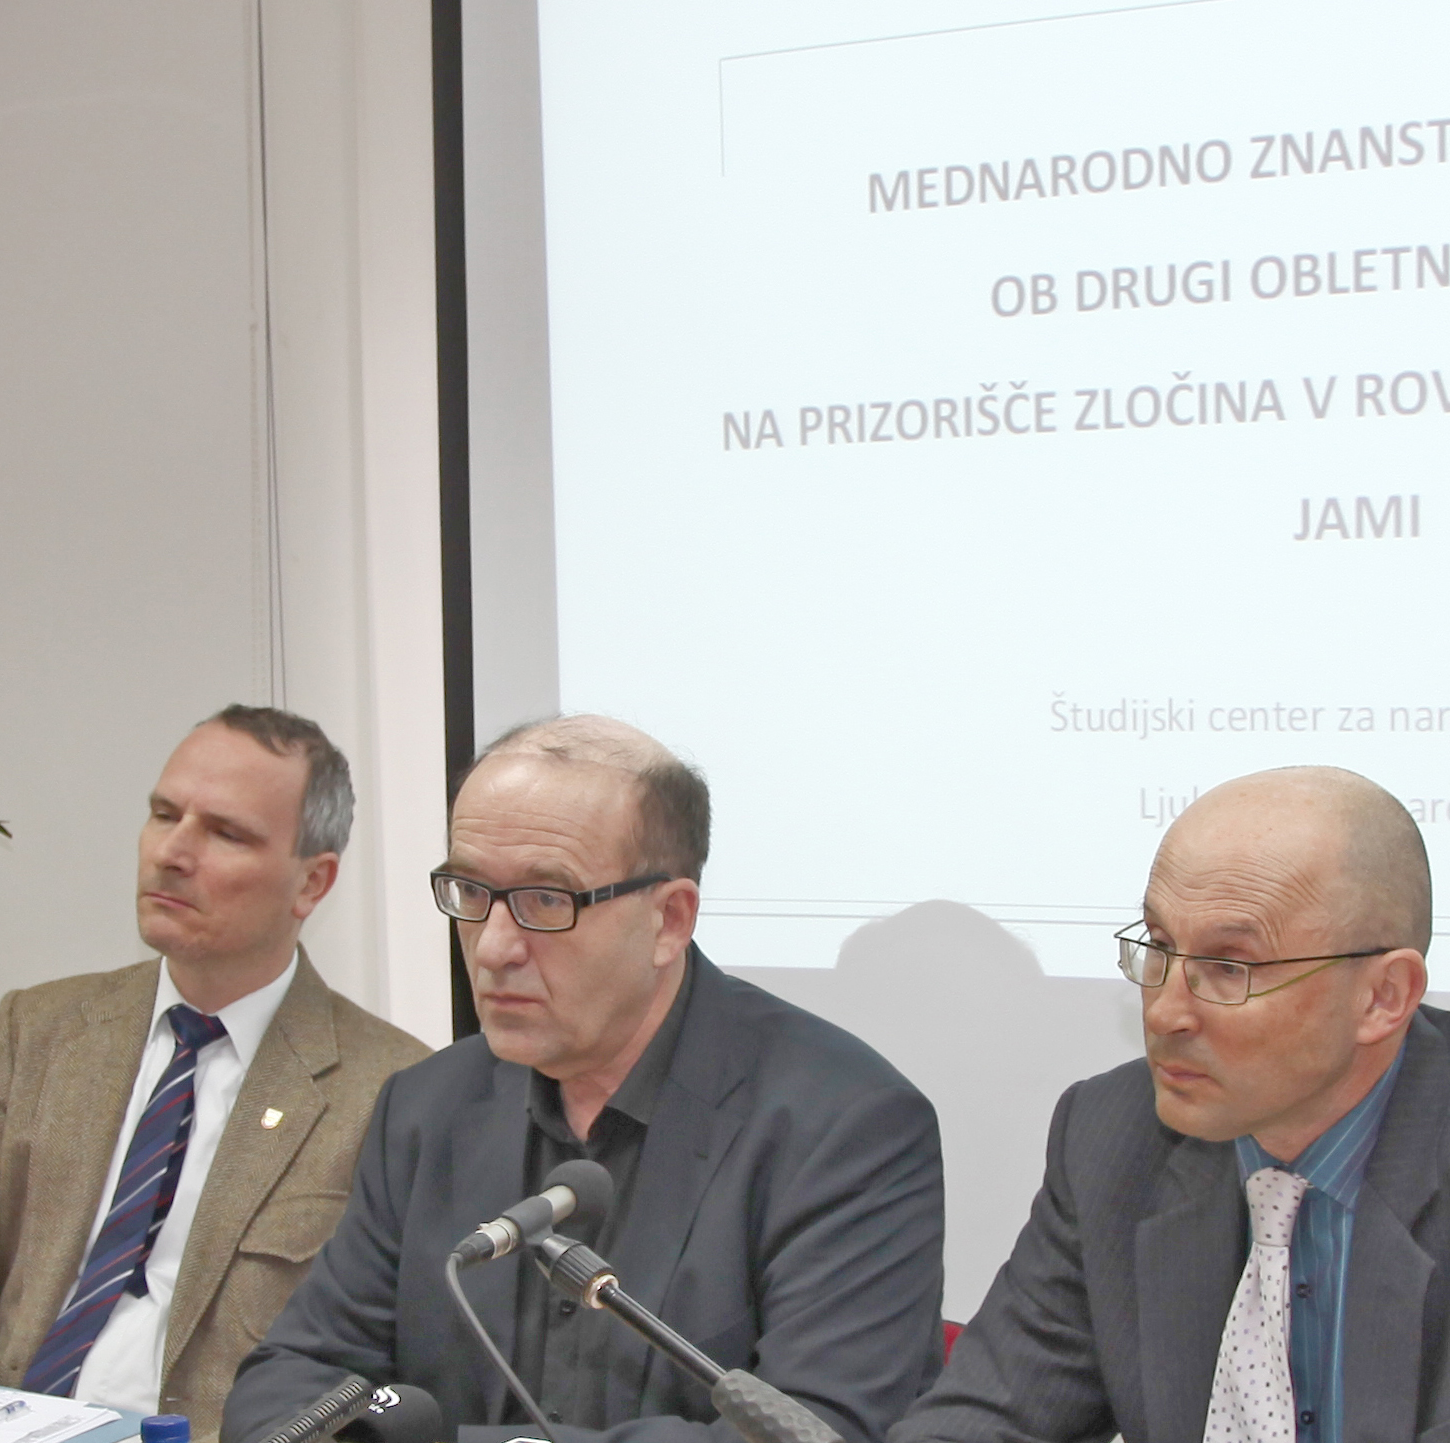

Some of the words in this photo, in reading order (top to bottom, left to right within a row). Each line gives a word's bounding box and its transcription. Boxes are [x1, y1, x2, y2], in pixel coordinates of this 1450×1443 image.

[867, 139, 1234, 213] MEDNARODNO
[990, 274, 1058, 317] OB
[1075, 260, 1232, 313] DRUGI
[723, 409, 784, 451] NA
[799, 380, 1058, 446] PRIZORIŠČE
[1074, 371, 1287, 432] ZLOČINA
[1303, 376, 1337, 420] V
[1294, 494, 1422, 541] JAMI
[1050, 691, 1195, 740] Študijski
[1209, 700, 1325, 733] center
[1338, 704, 1376, 732] za
